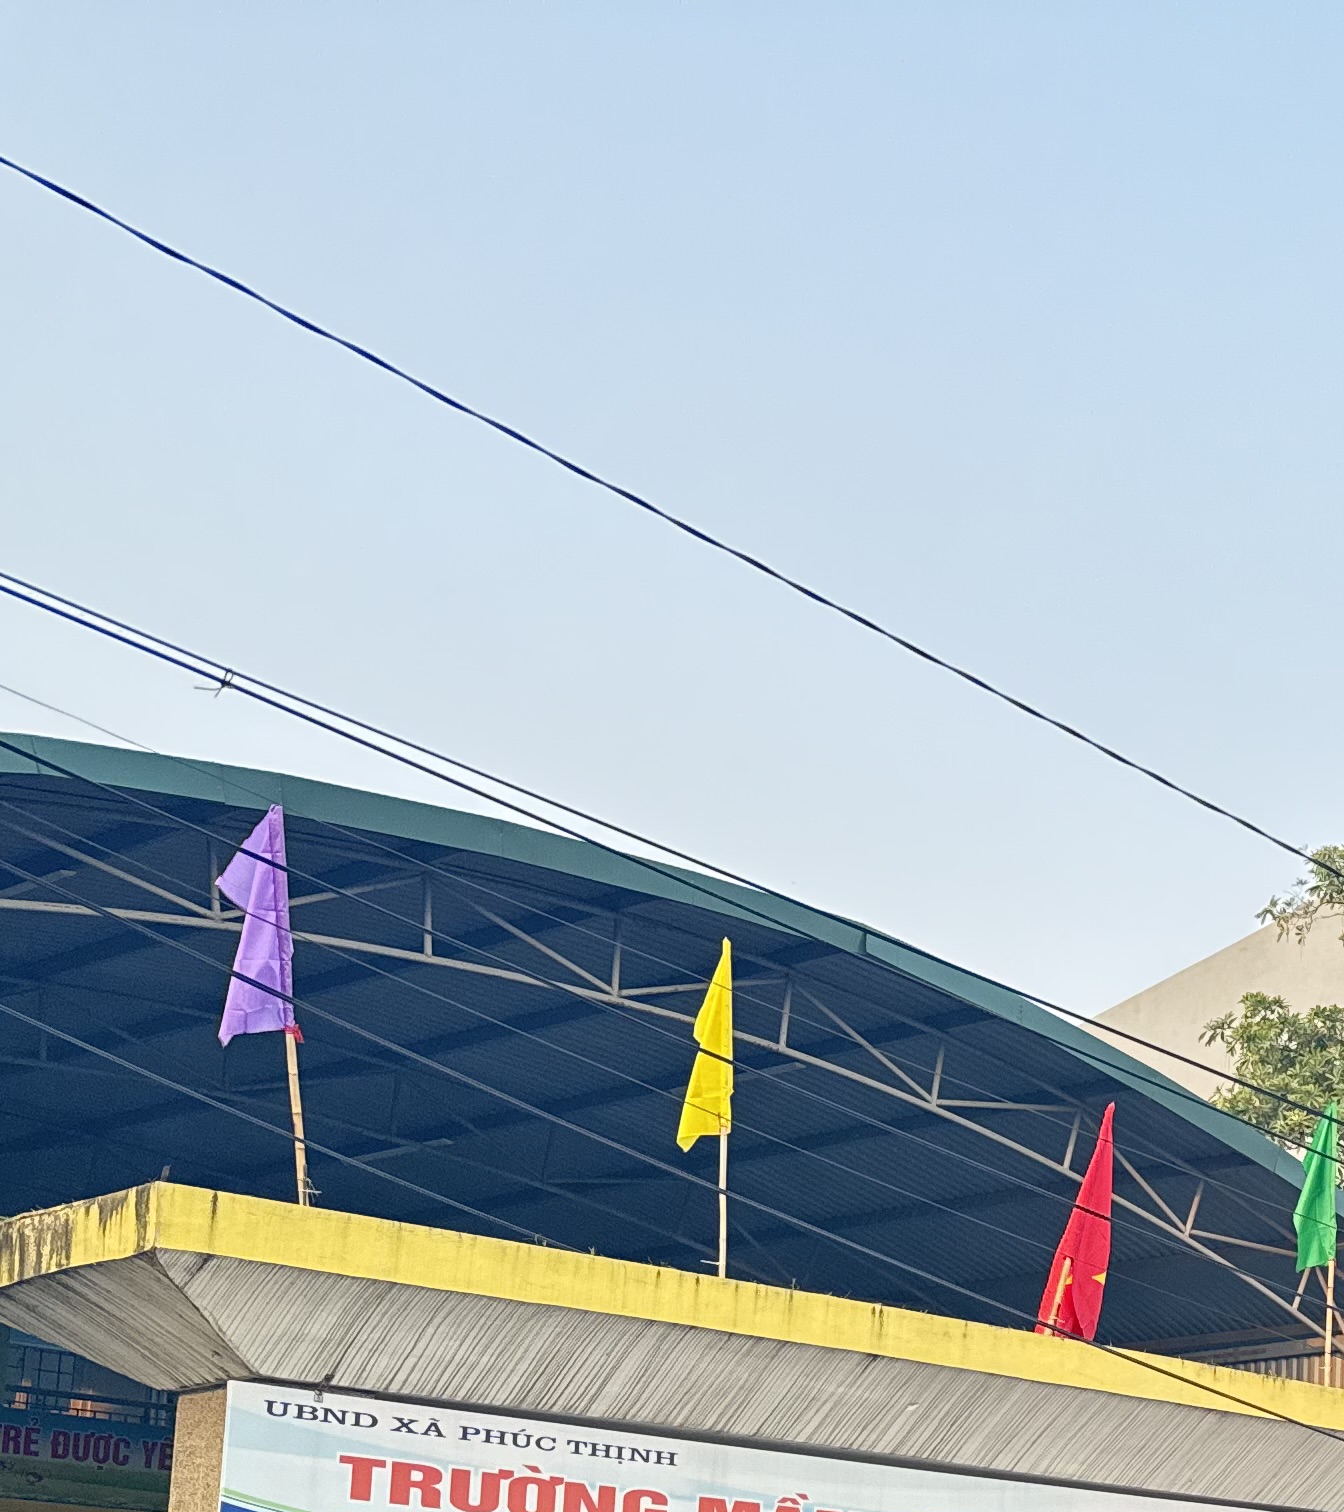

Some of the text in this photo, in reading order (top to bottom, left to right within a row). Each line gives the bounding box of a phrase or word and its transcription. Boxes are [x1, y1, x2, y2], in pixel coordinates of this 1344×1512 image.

[0, 1418, 39, 1457] RẺ
[50, 1429, 130, 1470] ĐƯỢC
[264, 1400, 679, 1466] UBND XÃ PHÚC THỊNH
